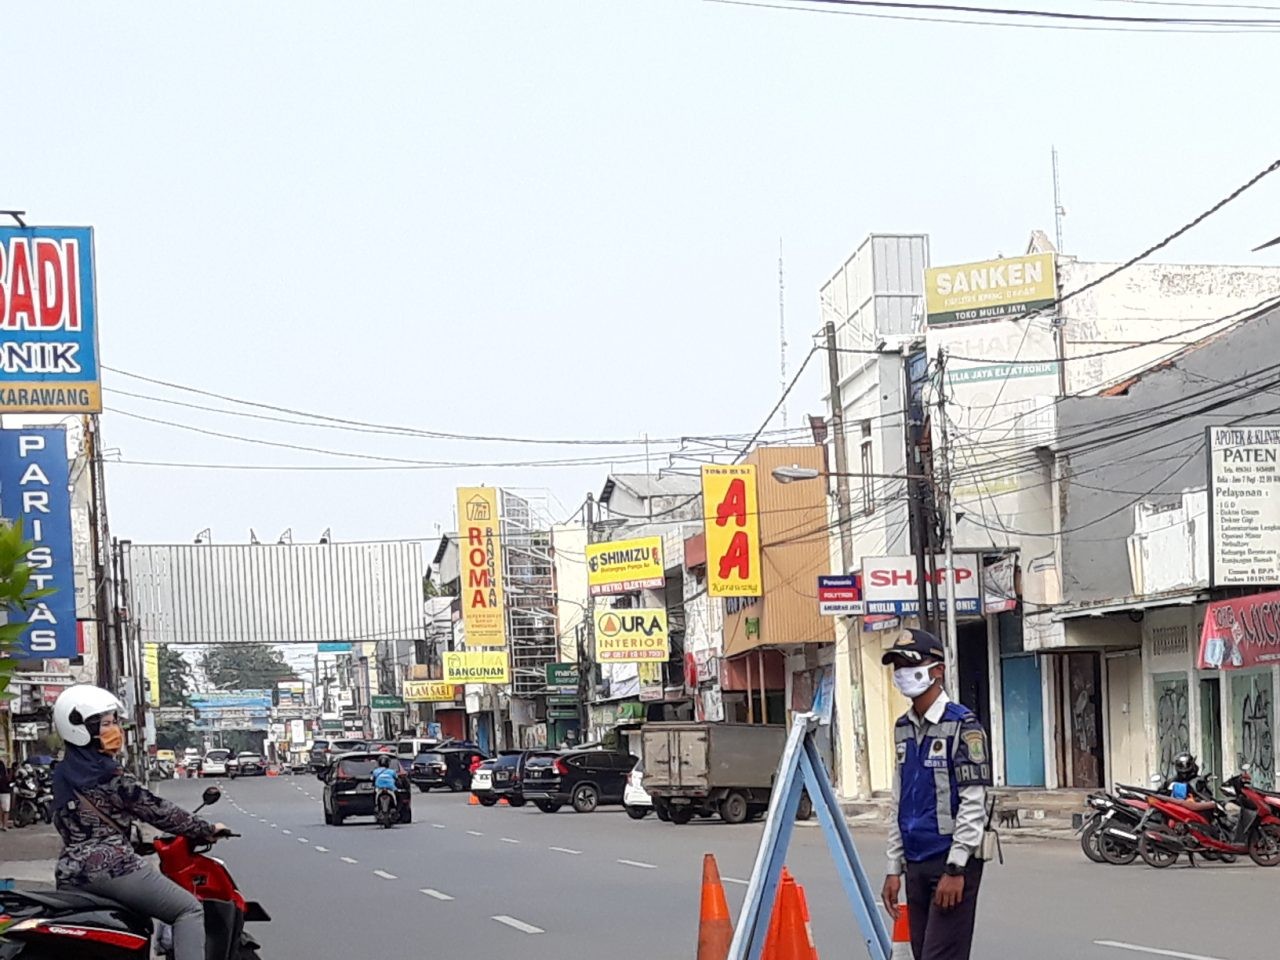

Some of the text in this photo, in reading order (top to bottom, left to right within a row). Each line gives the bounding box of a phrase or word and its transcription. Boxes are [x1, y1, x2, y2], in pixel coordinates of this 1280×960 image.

[0, 239, 80, 330] ADI
[936, 262, 1043, 296] SANKEN
[956, 303, 1028, 321] TOKO MULIA JAYA
[0, 343, 79, 372] NIK
[1223, 448, 1277, 462] PATEN
[19, 435, 58, 652] PARISTAS
[600, 547, 650, 566] SHIMIZU
[467, 526, 488, 608] ROMA
[485, 526, 498, 608] BANGUNAN
[869, 602, 896, 613] MULIA
[599, 638, 664, 648] INTERIOR
[448, 667, 504, 677] BANGUNAN
[405, 685, 429, 697] ALAM
